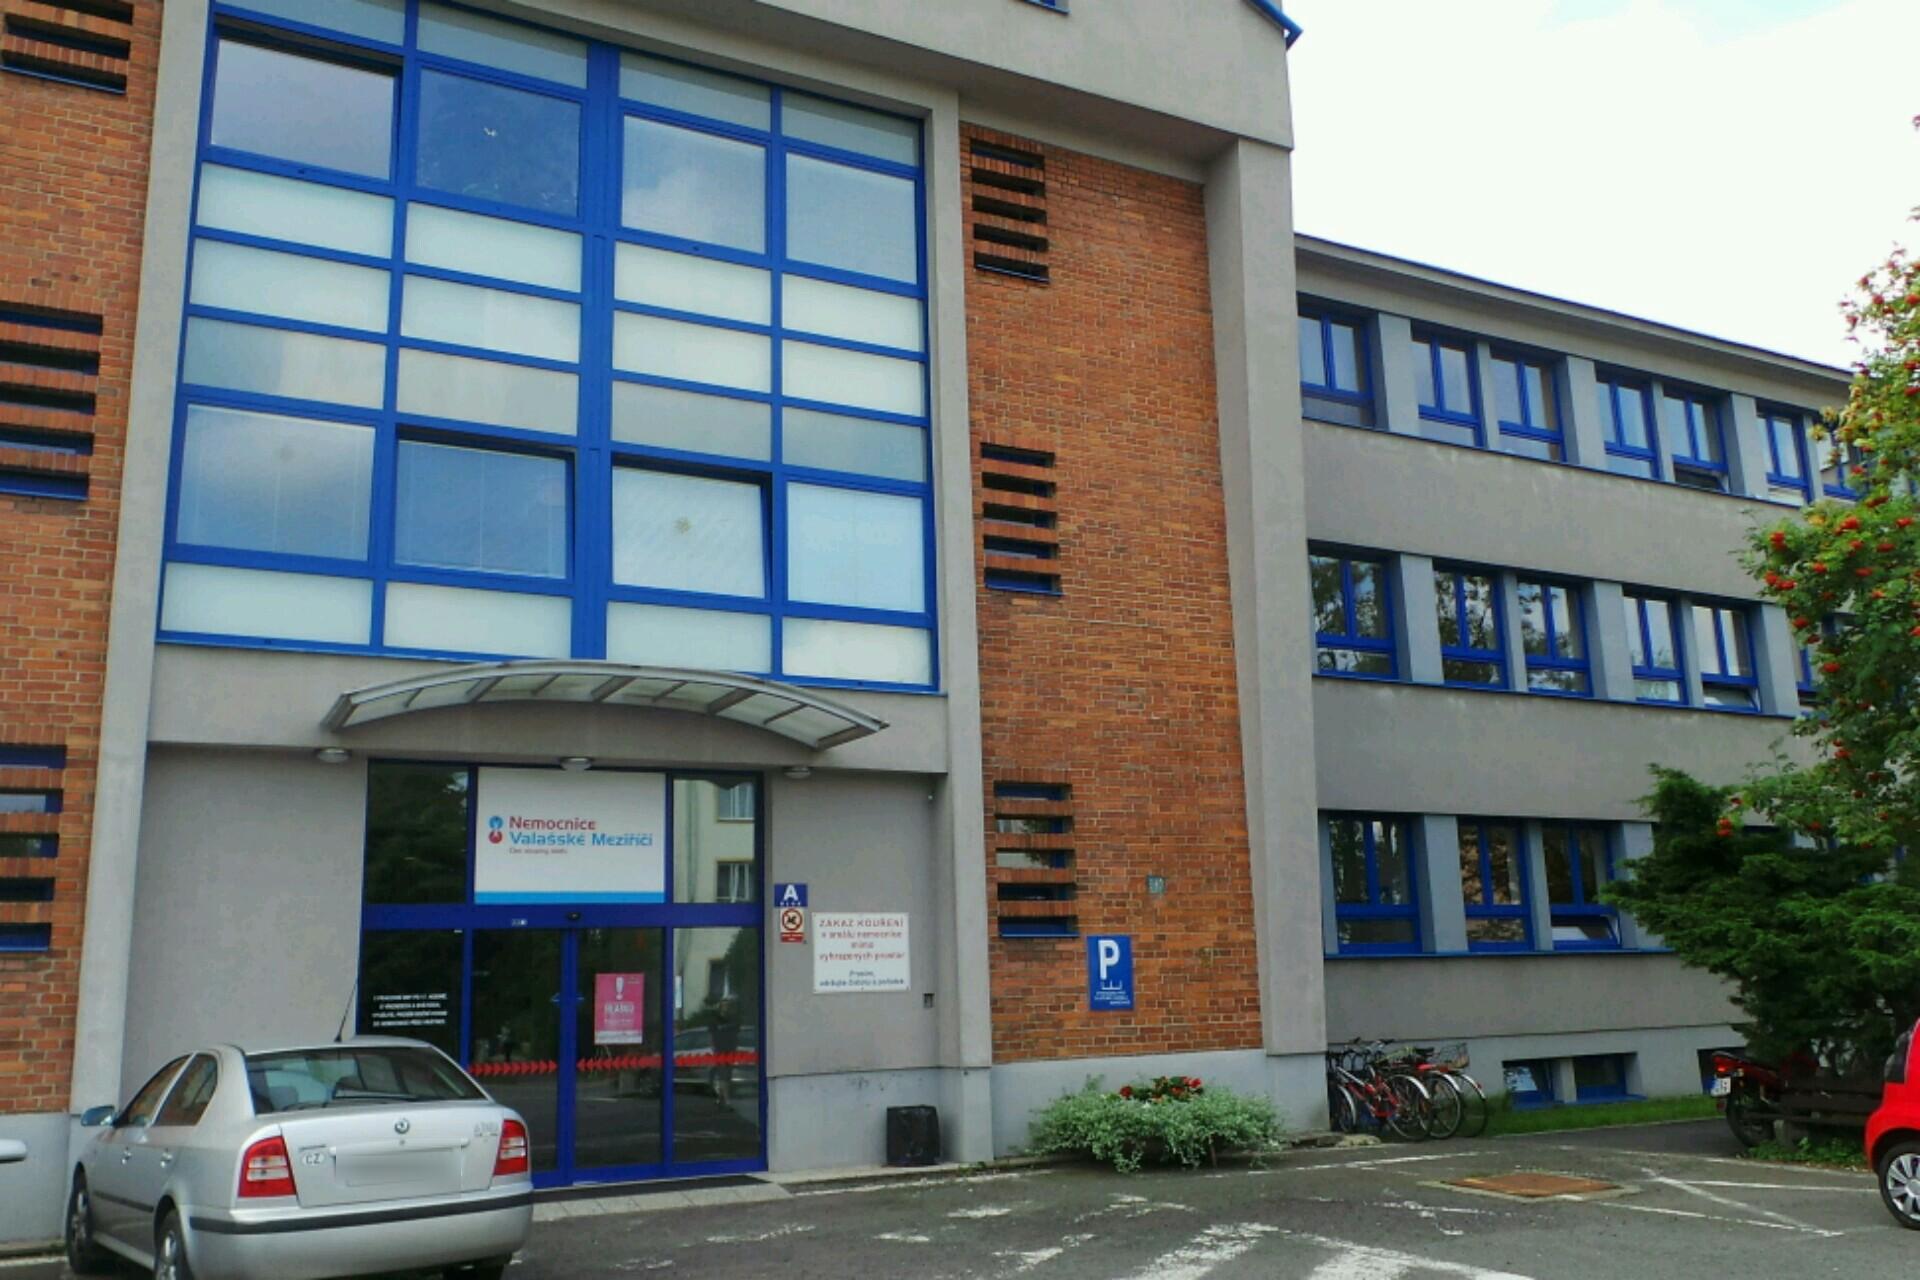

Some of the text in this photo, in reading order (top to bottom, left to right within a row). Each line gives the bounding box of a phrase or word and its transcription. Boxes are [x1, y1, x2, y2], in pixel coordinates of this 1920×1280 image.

[509, 815, 597, 830] Nemocnice
[509, 831, 653, 846] Valašské Meziříčí
[783, 884, 799, 901] A
[1098, 939, 1120, 980] P
[306, 1152, 321, 1165] CZ
